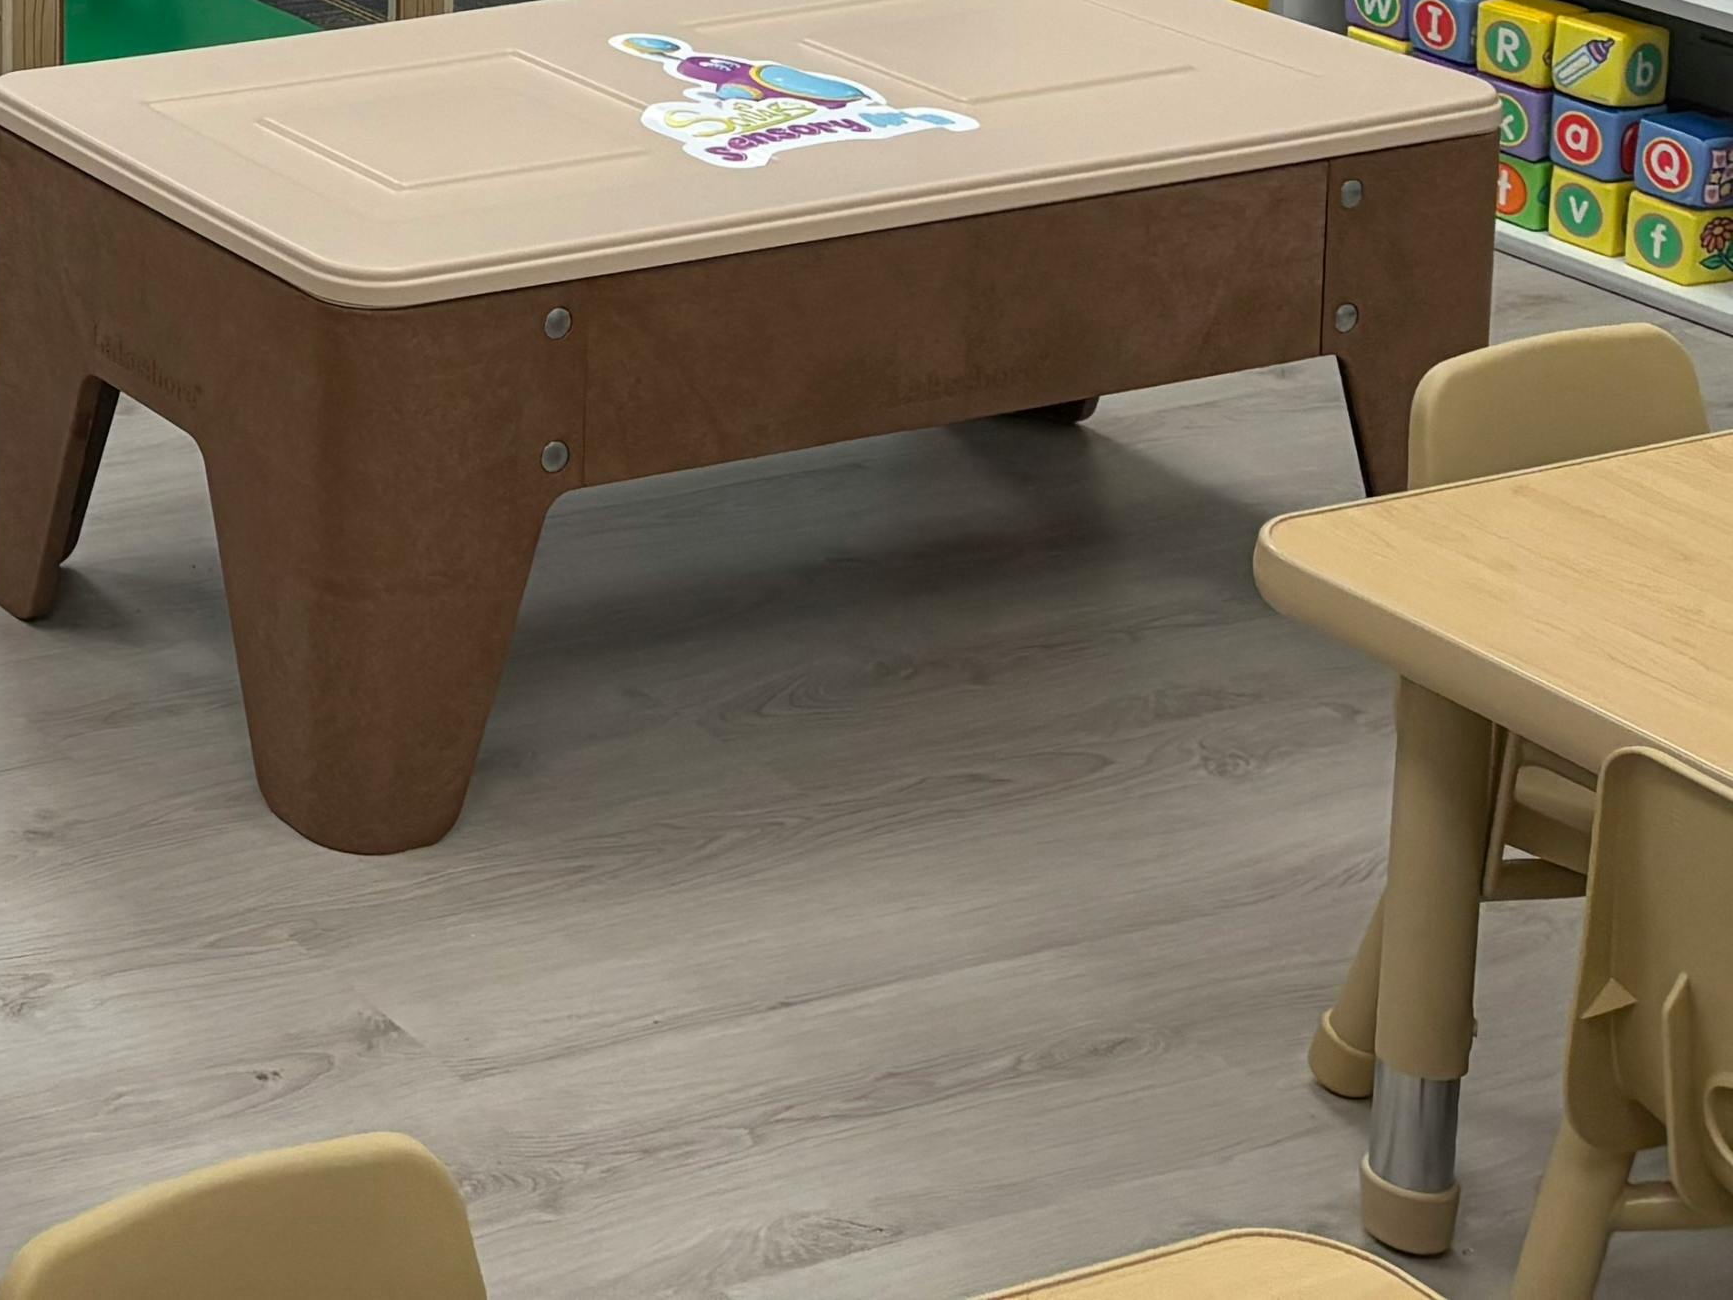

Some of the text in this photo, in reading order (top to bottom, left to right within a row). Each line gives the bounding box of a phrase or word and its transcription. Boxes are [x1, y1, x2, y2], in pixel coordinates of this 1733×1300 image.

[1426, 2, 1444, 43] I
[1495, 27, 1520, 68] R
[1635, 51, 1654, 88] b
[1564, 121, 1589, 153] a
[1650, 143, 1681, 186] Q
[1568, 199, 1590, 225] v
[1650, 223, 1668, 260] f
